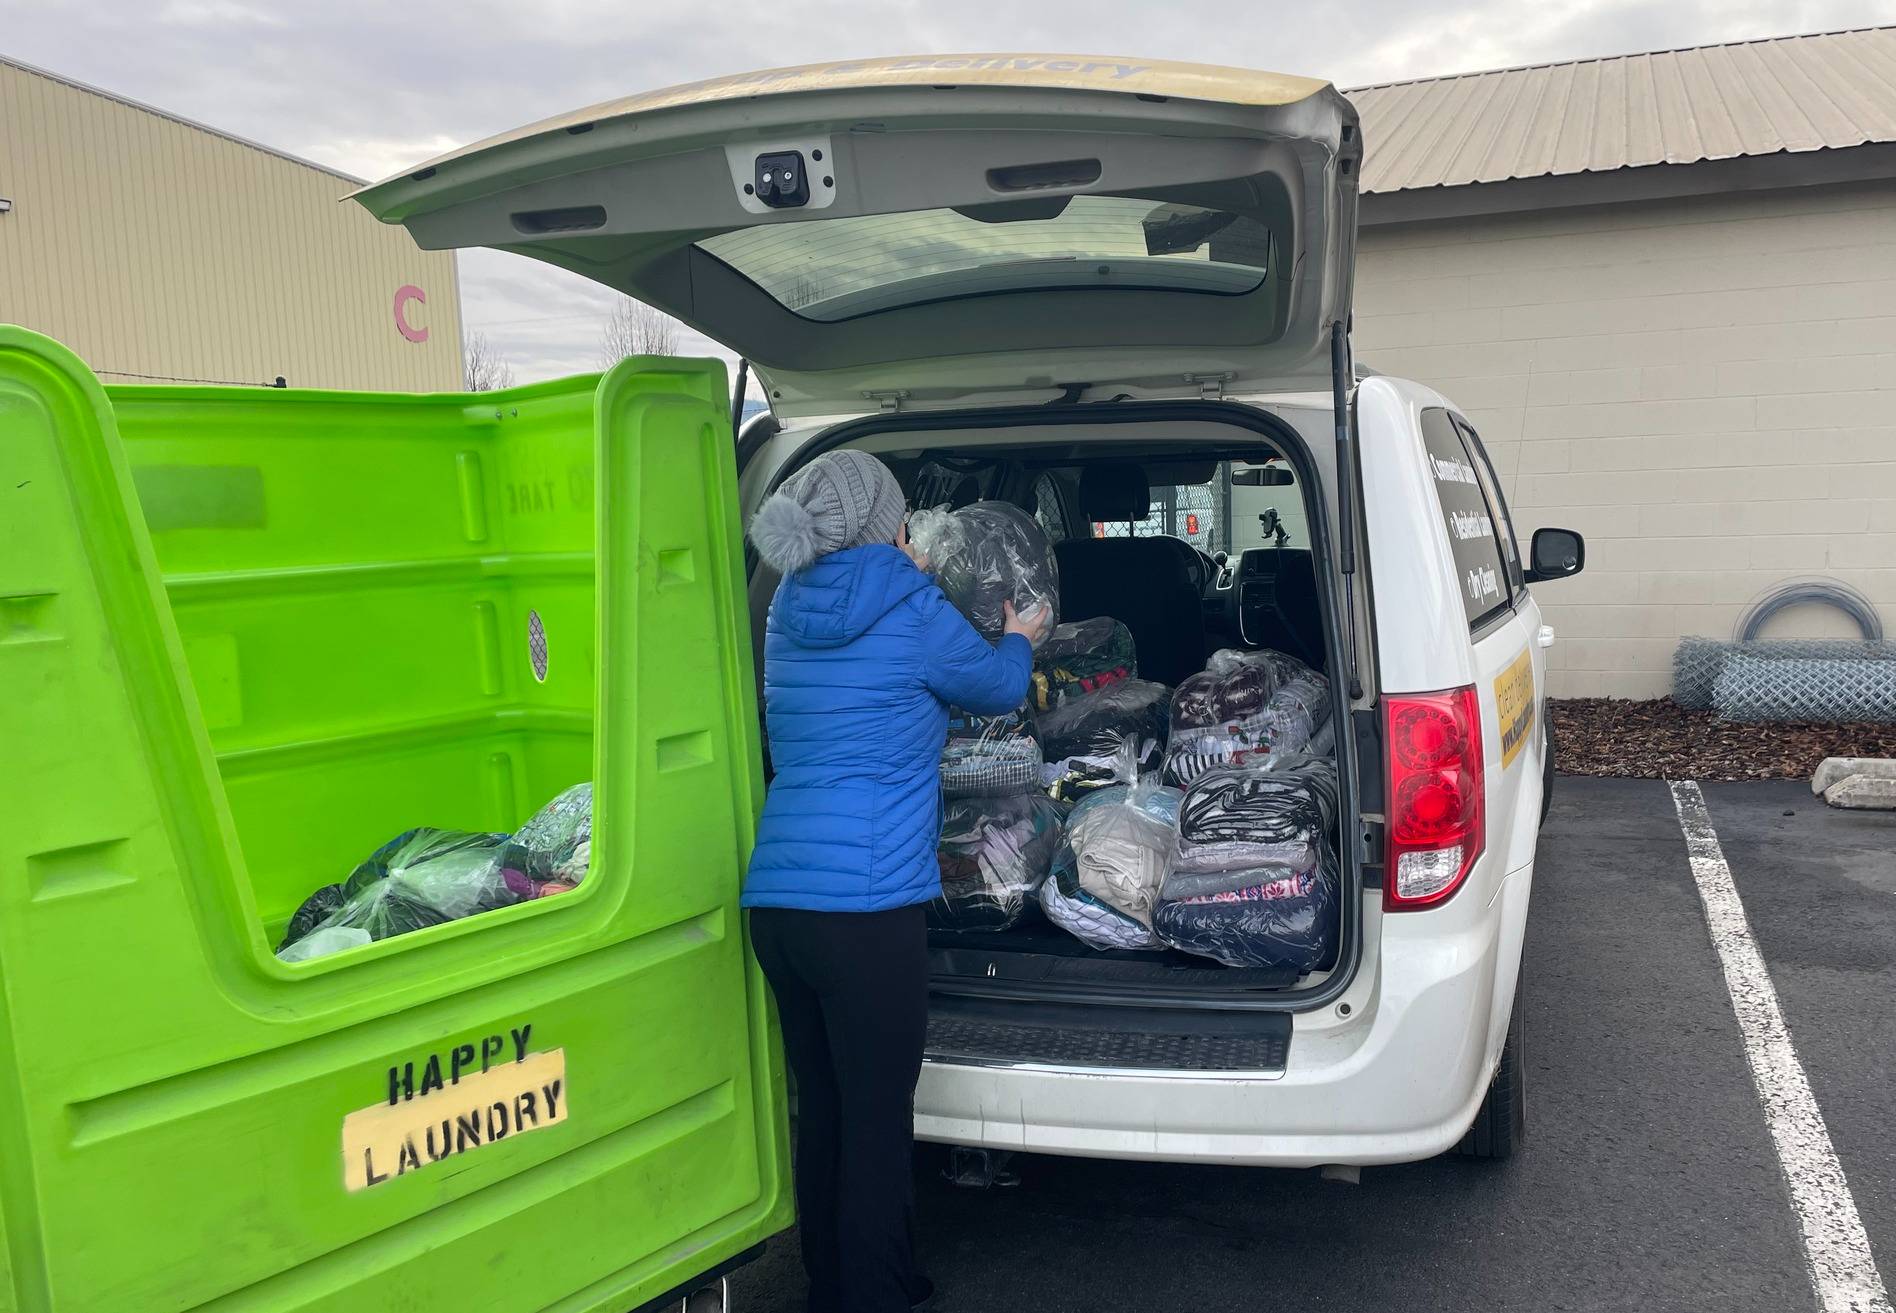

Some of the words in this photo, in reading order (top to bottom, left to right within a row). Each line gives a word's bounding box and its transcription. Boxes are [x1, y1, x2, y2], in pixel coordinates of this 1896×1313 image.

[393, 284, 429, 343] C
[388, 1024, 532, 1106] HAPPY
[364, 1080, 561, 1187] LAUNDRY
